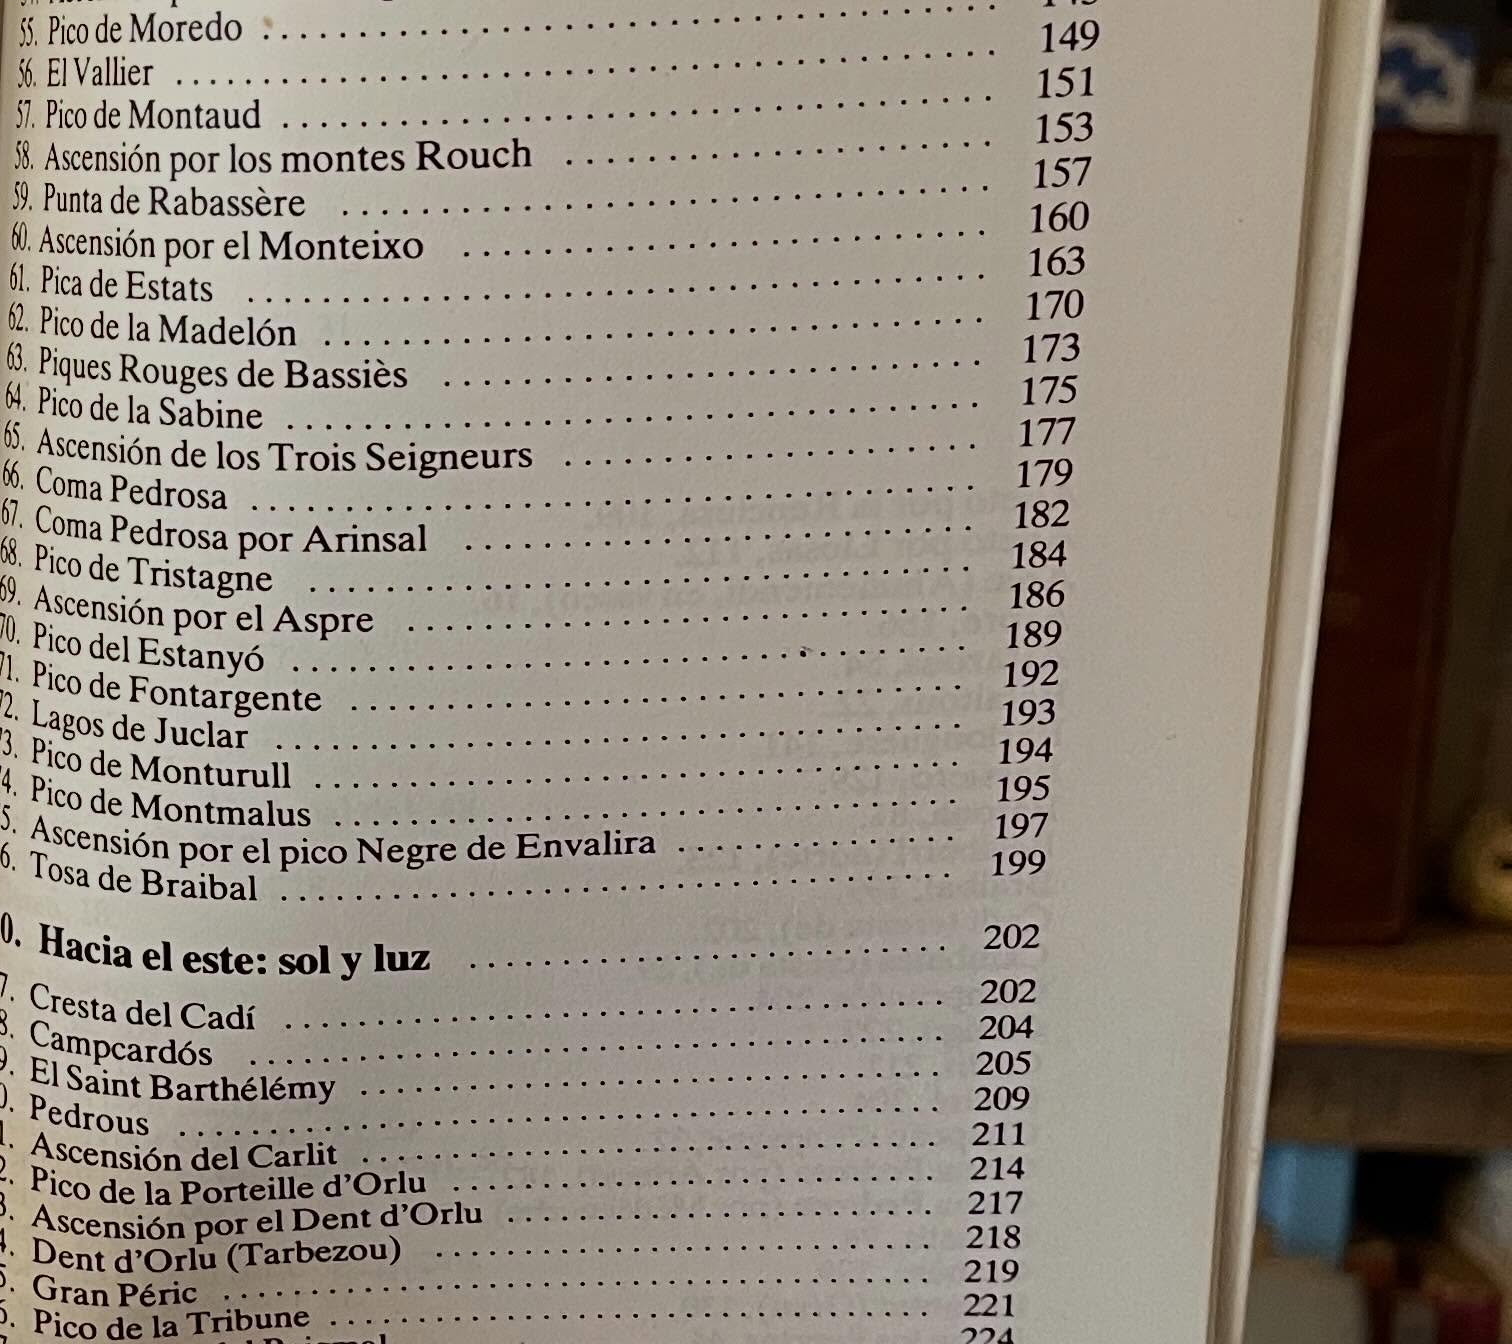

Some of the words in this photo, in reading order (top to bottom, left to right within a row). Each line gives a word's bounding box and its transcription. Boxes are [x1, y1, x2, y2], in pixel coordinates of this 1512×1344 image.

[17, 58, 38, 89] 56.
[46, 57, 67, 88] El
[72, 55, 155, 87] Vallier
[1041, 19, 1100, 54] 149
[5, 341, 29, 372] 63.
[38, 345, 112, 387] Piques
[118, 353, 229, 395] Rouges
[237, 358, 275, 389] de
[283, 358, 408, 390] Bassiès
[1023, 332, 1081, 364] 173
[2, 420, 26, 452] 65.
[36, 427, 163, 467] Ascensión
[170, 438, 207, 469] de
[216, 440, 261, 471] los
[267, 442, 357, 472] Trois
[365, 441, 533, 480] Seigneurs
[1019, 416, 1077, 448] 177
[32, 620, 82, 657] Pico
[88, 632, 131, 664] del
[137, 636, 265, 679] Estanyó
[1007, 619, 1063, 649] 189
[31, 698, 105, 742] Lagos
[112, 713, 146, 743] de
[153, 716, 249, 750] Juclar
[1002, 698, 1056, 727] 193
[38, 922, 133, 969] Hacia
[141, 940, 174, 972] el
[182, 946, 268, 976] este:
[278, 944, 332, 976] sol
[340, 952, 363, 982] y
[373, 943, 431, 973] luz
[983, 923, 1040, 950] 202
[29, 1019, 213, 1067] Campcardós
[978, 1014, 1035, 1041] 204
[32, 1273, 111, 1308] Gran
[116, 1280, 198, 1309] Péric
[964, 1258, 1020, 1284] 219
